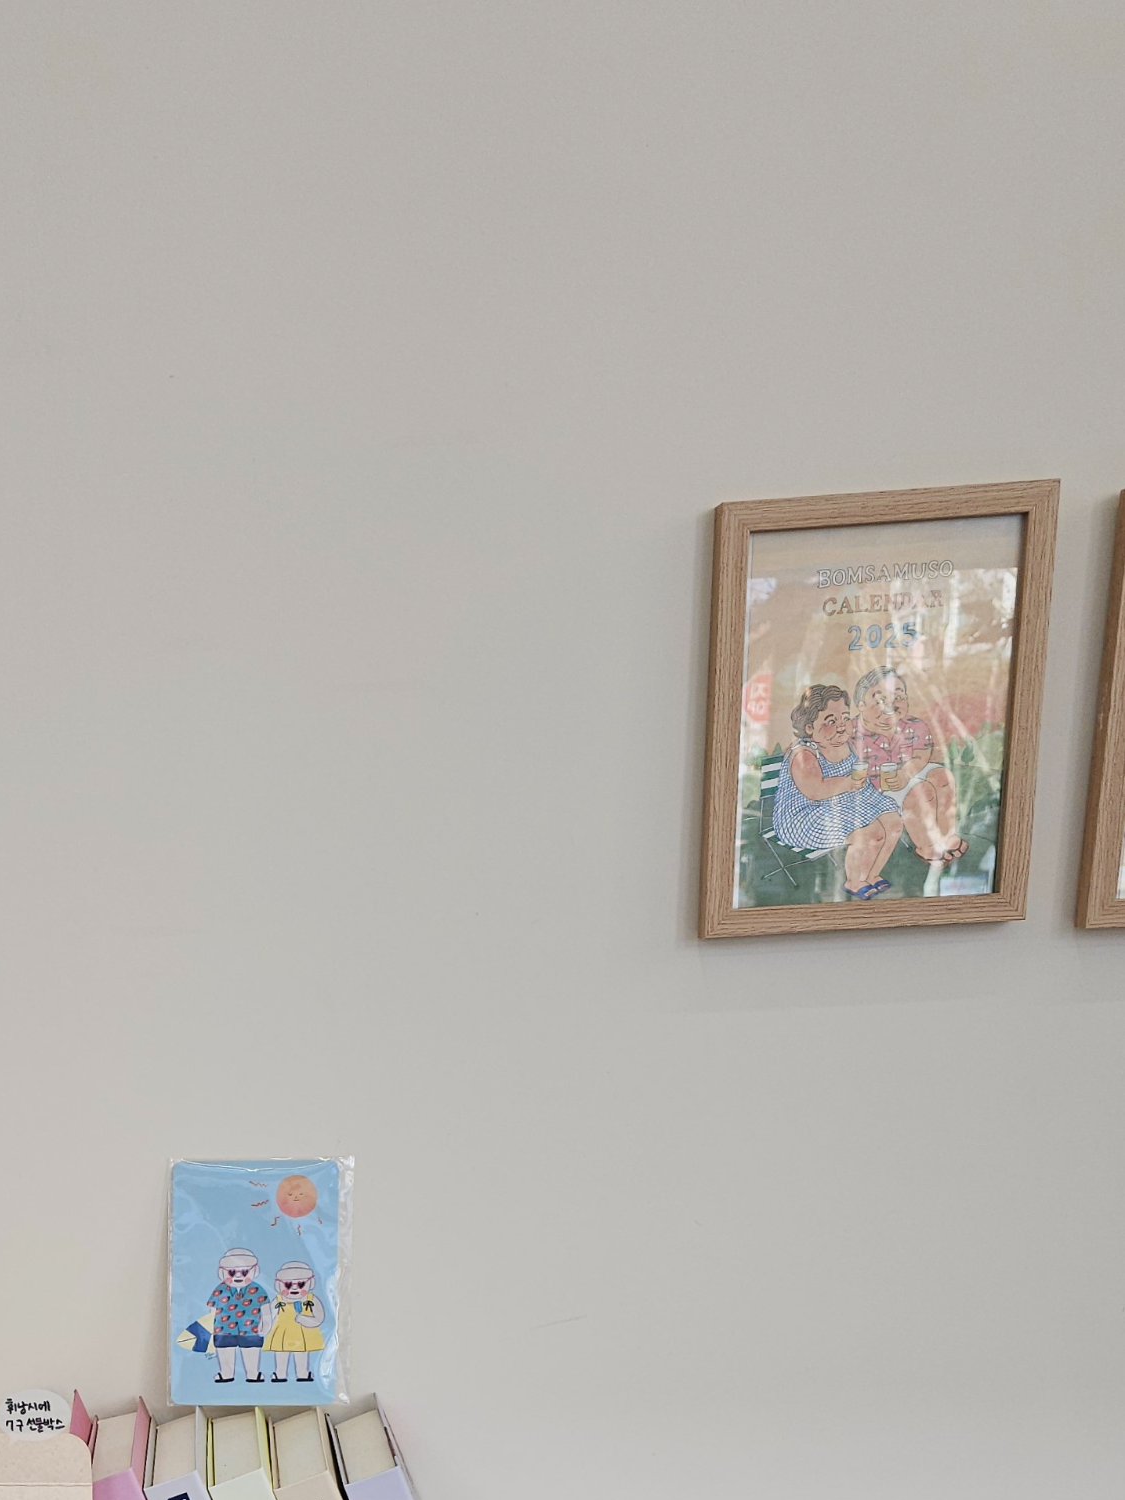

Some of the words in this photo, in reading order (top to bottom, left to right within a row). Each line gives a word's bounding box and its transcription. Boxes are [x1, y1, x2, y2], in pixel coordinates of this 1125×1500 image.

[817, 560, 954, 589] BOMSAMUSO
[822, 590, 943, 616] CALENDAR
[848, 622, 918, 650] 2025
[5, 1398, 51, 1415] 휘낭시에
[26, 1417, 65, 1433] 선물박스
